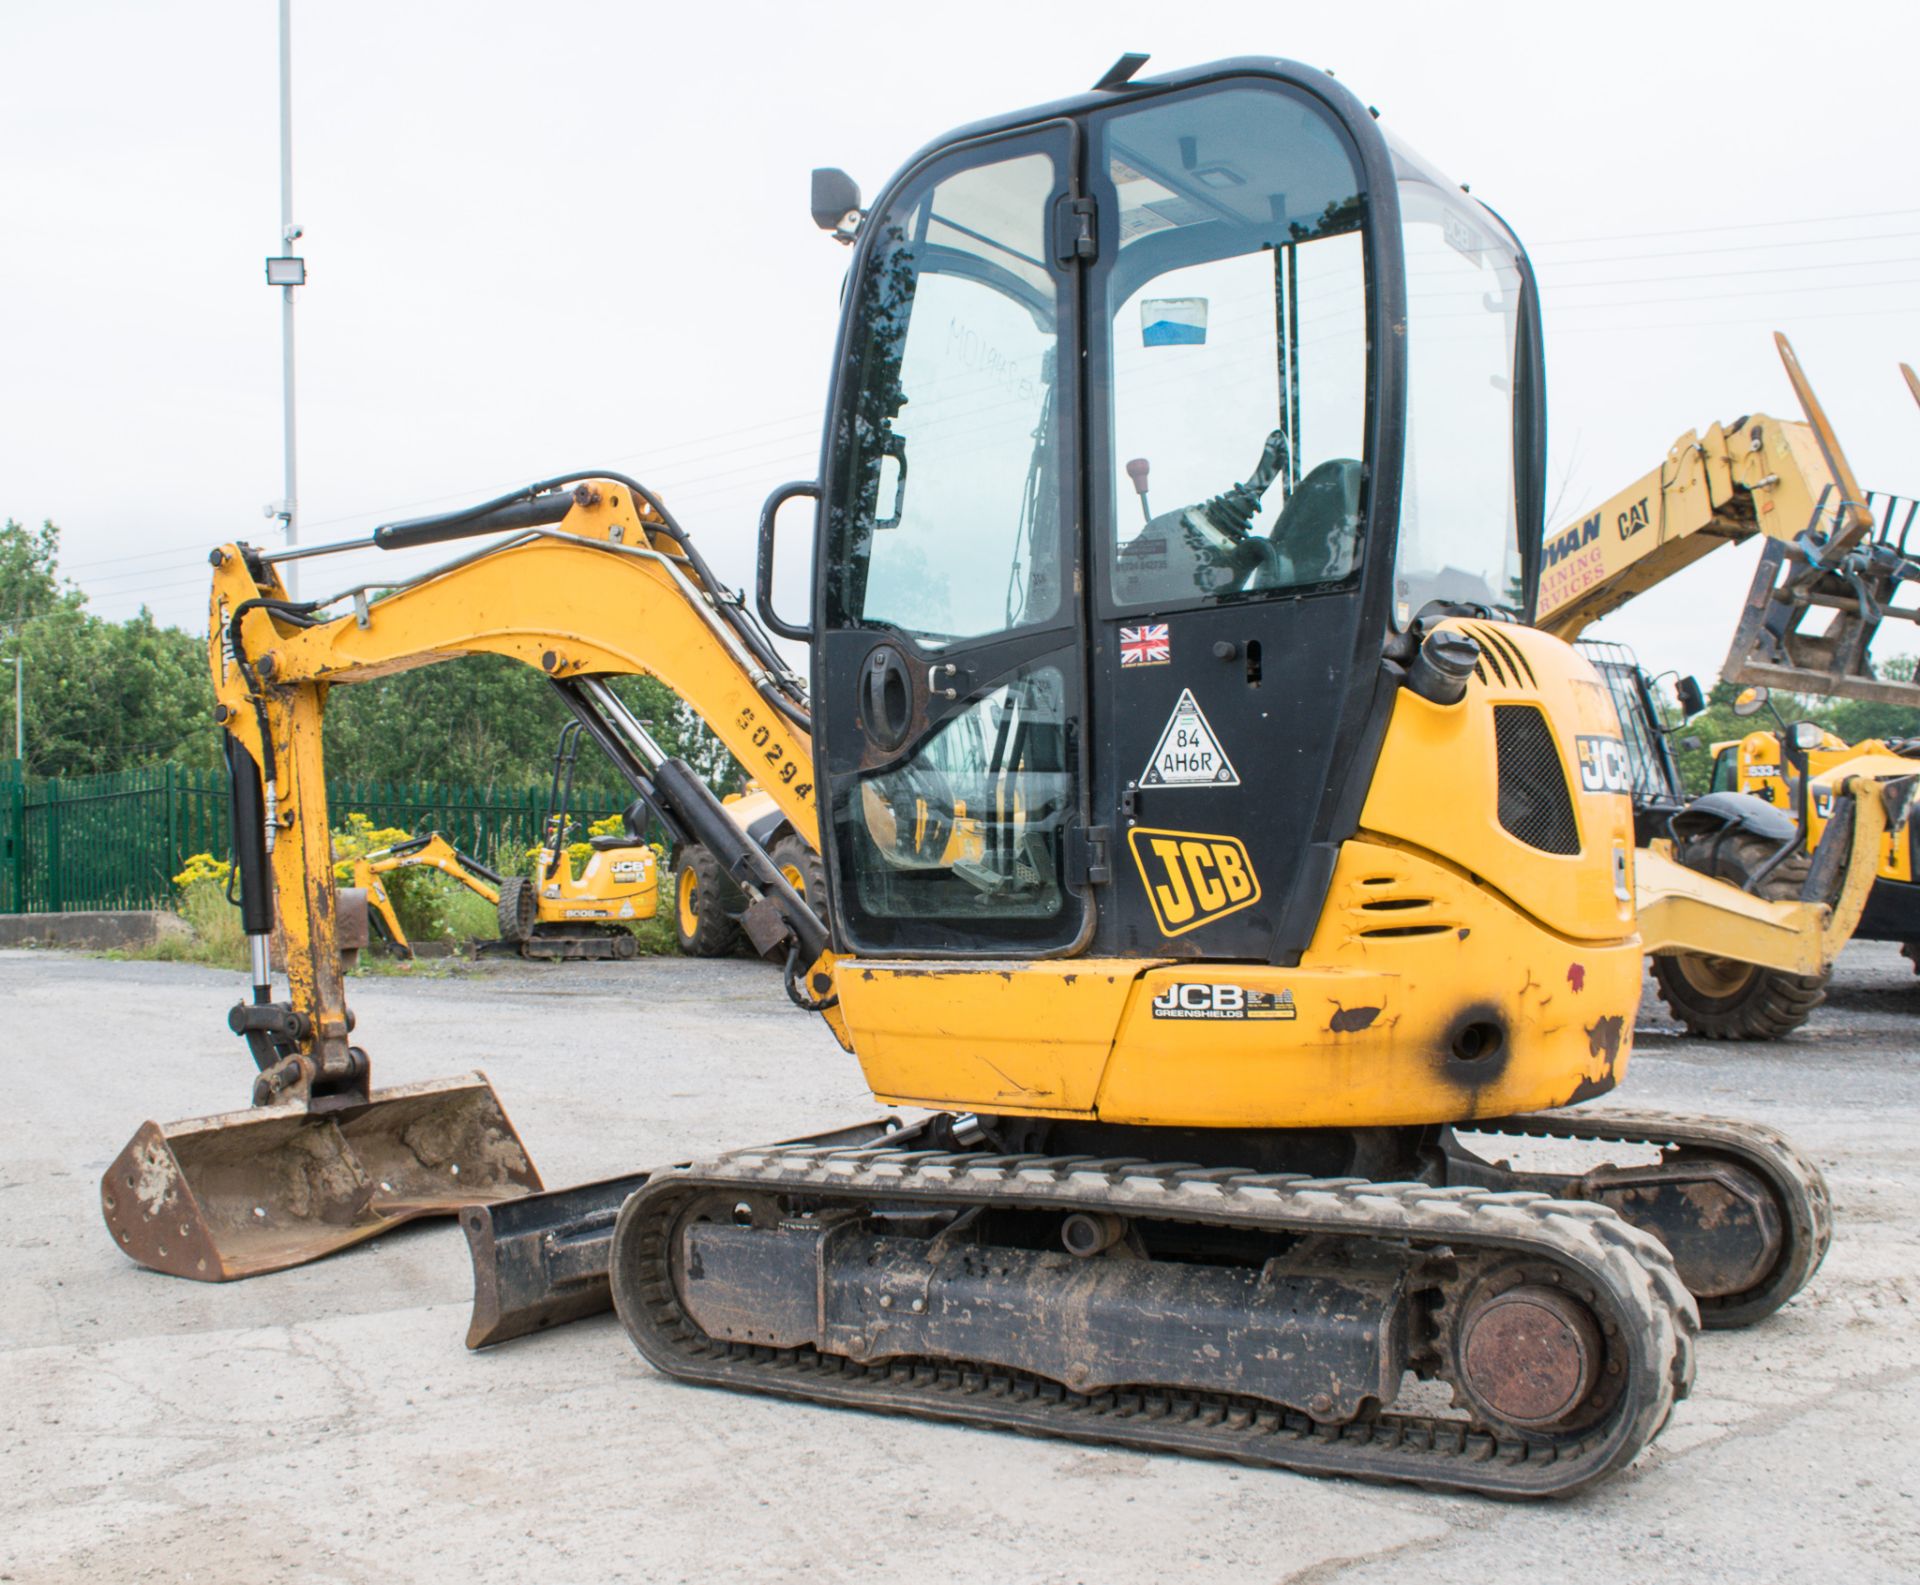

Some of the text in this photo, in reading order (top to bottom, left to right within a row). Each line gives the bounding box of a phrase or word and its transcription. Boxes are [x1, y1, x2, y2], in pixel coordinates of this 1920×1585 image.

[1617, 497, 1650, 541] CAT
[1176, 728, 1200, 748] 84
[1163, 752, 1212, 772] AH6R
[610, 861, 645, 872] JCB
[1150, 838, 1252, 924] JCB
[1154, 984, 1245, 1010] JCB
[1154, 1009, 1245, 1018] GREENSHIELDS
